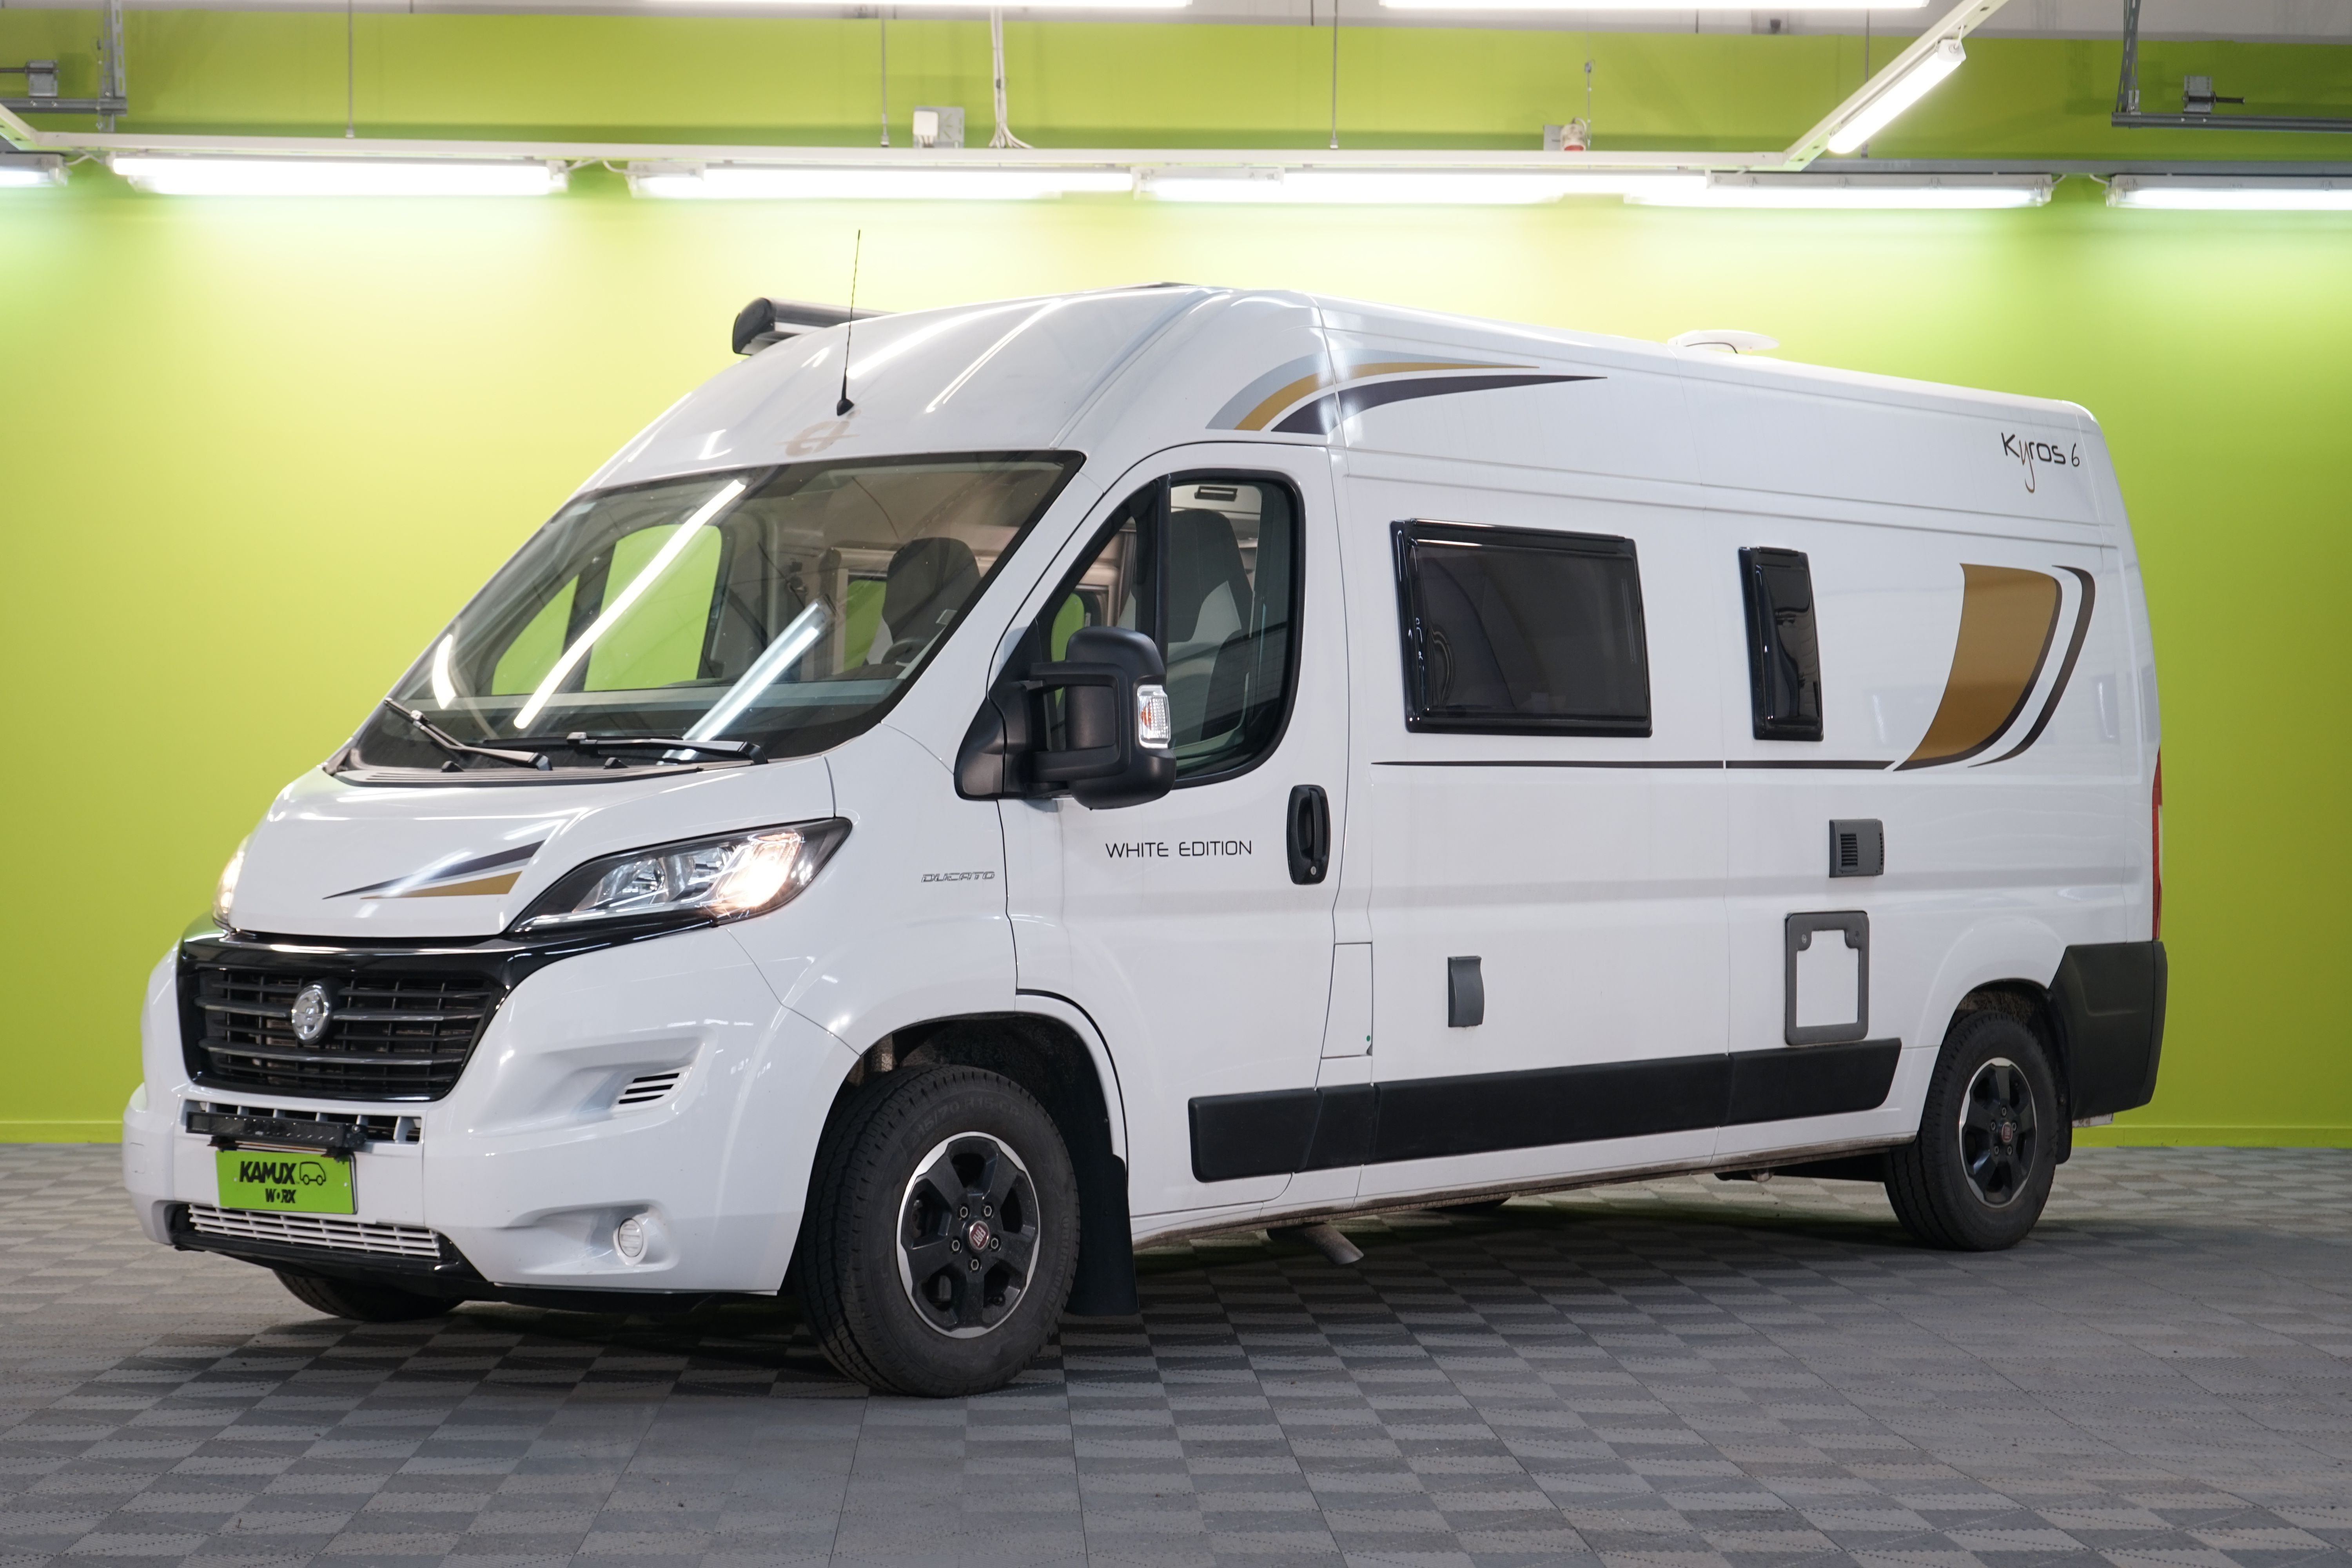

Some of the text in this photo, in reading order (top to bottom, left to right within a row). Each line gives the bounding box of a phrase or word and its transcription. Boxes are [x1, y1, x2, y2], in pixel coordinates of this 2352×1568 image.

[2001, 432, 2080, 493] Kyros 6
[1105, 840, 1252, 858] WHITE EDITION
[921, 871, 995, 882] DUCATO
[239, 1161, 297, 1185] KAMUX
[973, 1225, 986, 1246] FIAT
